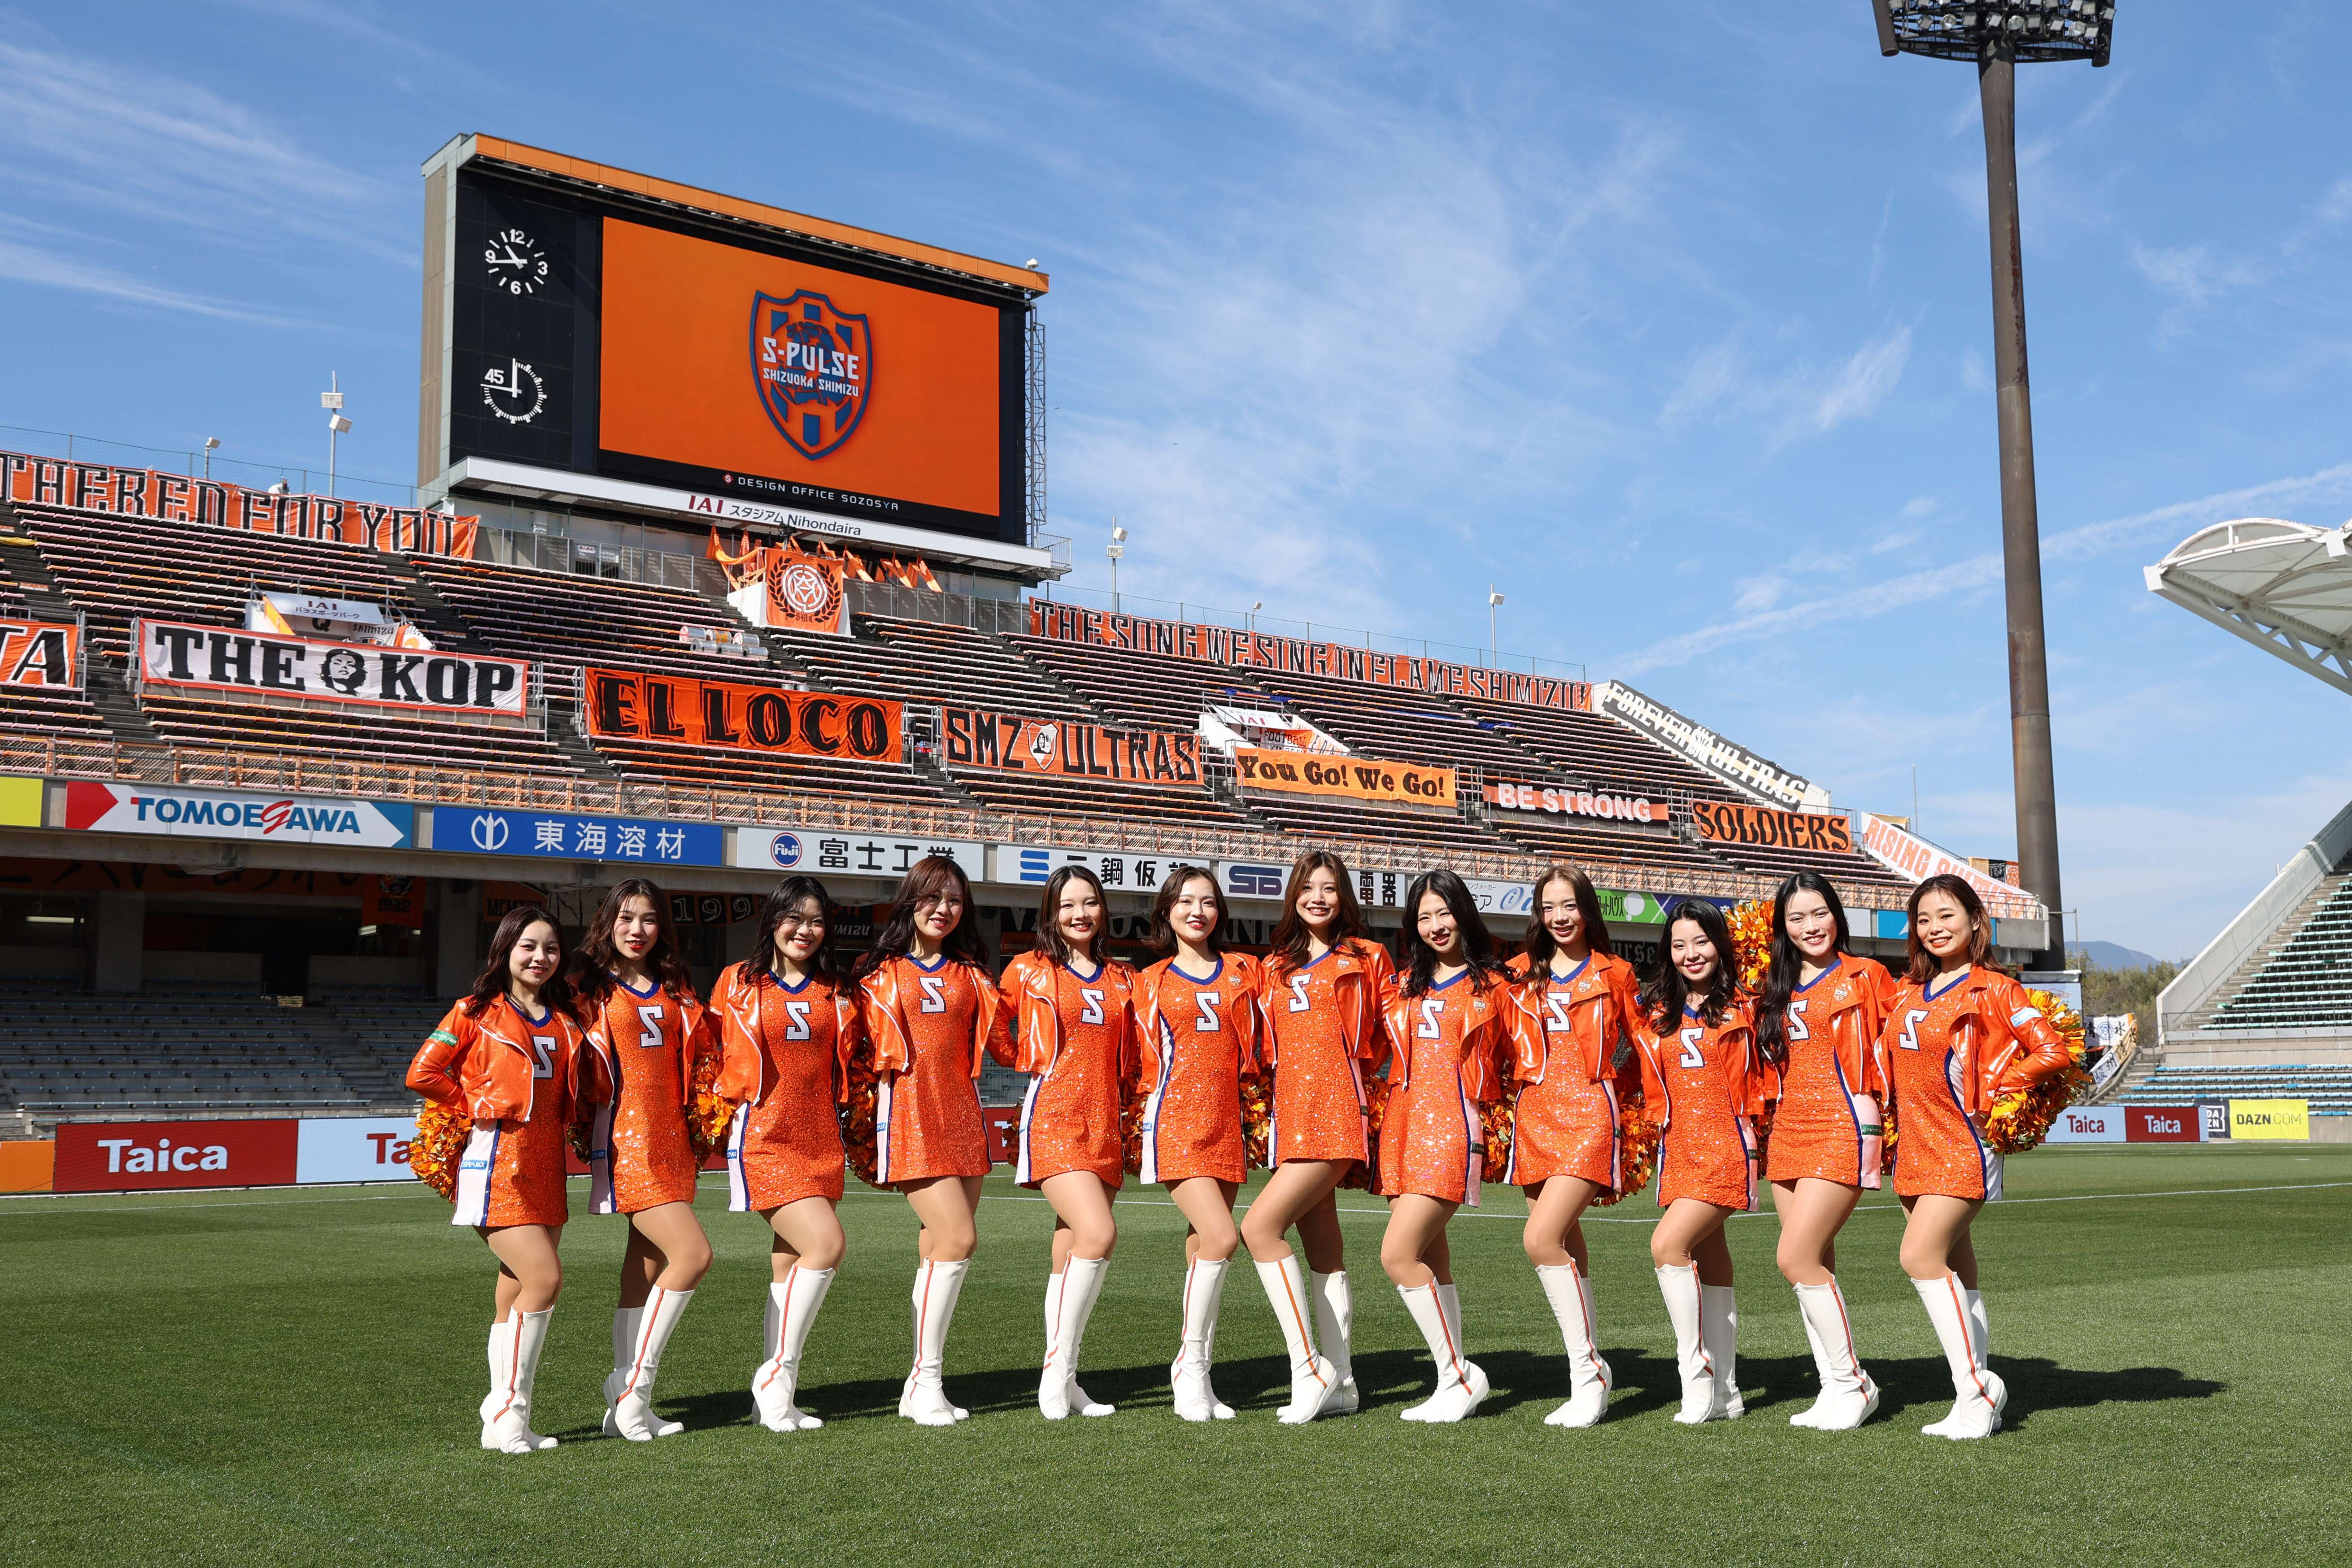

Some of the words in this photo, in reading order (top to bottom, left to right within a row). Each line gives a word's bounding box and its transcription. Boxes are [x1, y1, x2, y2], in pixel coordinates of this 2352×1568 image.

[510, 229, 525, 244] 12
[485, 250, 496, 263] 9
[538, 261, 548, 275] 3
[510, 281, 521, 295] 6
[763, 336, 859, 380] S-PULSE
[485, 369, 505, 384] 45
[763, 368, 813, 388] SHIZUOKA
[819, 379, 858, 396] SHIMIZU
[688, 495, 723, 514] IAI
[738, 476, 786, 492] DESIGN
[792, 486, 835, 500] OFFICE
[841, 494, 898, 510] SOZOSYA
[308, 601, 337, 610] IAI
[1034, 599, 1103, 645] THE
[156, 627, 306, 691] THE
[379, 653, 514, 707] KOP
[947, 709, 1026, 769] SMZ
[1062, 723, 1198, 781] ULTRAS
[1264, 730, 1307, 747] FOOTBALL
[1606, 682, 1693, 749] FOREVER
[1710, 741, 1806, 805] ULTRAS
[1237, 755, 1298, 782] You
[1304, 760, 1349, 787] Go!
[1355, 767, 1394, 792] We
[1402, 772, 1445, 798] Go!
[1498, 783, 1536, 811] BE
[1542, 788, 1651, 823] STRONG
[534, 820, 686, 859] 東海溶材
[1693, 801, 1849, 852] SOLDIERS
[775, 843, 799, 856] Fuji
[1865, 815, 1932, 880] RISING
[673, 897, 765, 922] 199
[2066, 1115, 2105, 1133] Taica
[2144, 1115, 2182, 1134] Taica
[2236, 1113, 2302, 1125] DAZN.COM
[97, 1138, 228, 1173] Taica
